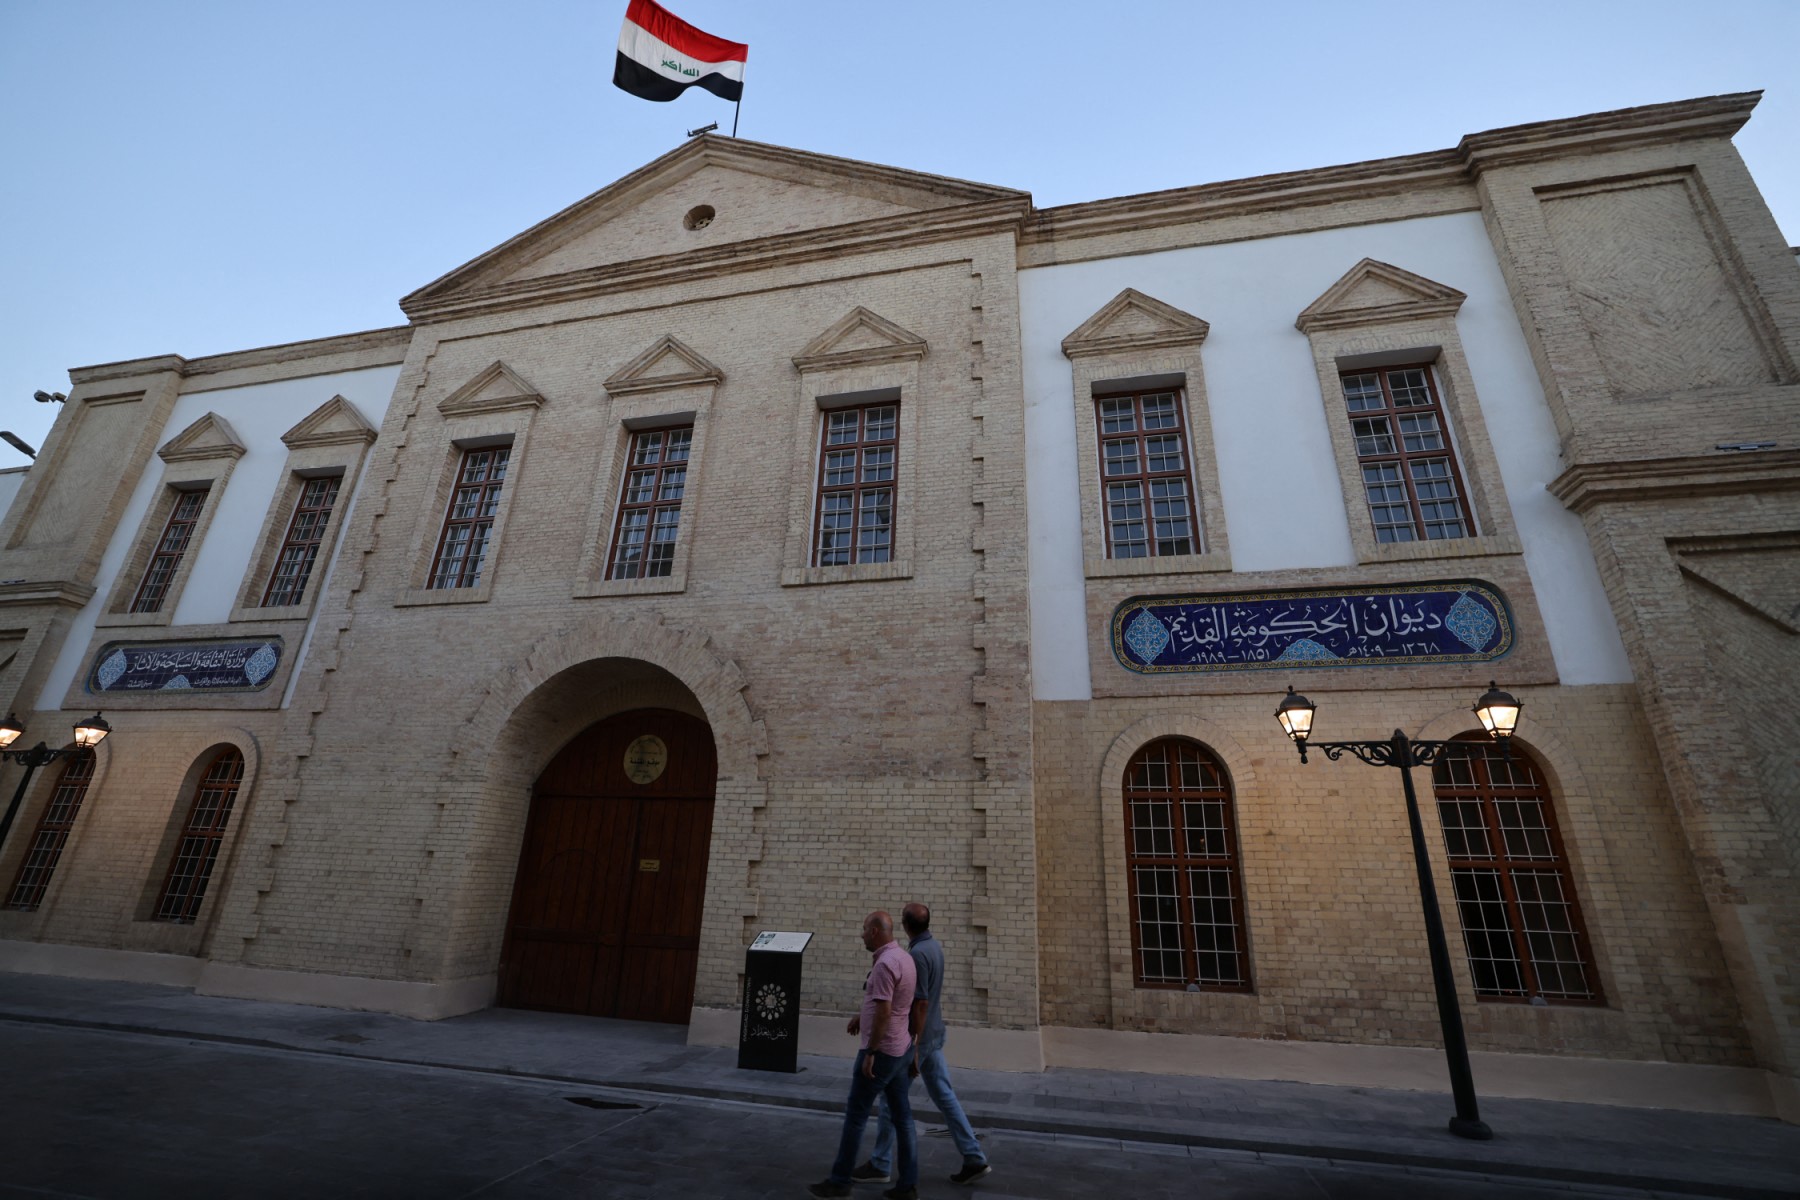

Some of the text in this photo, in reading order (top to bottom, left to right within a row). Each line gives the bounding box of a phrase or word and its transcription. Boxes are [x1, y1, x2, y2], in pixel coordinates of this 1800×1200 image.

[682, 68, 699, 77] الله
[1230, 599, 1359, 647] الحكومة
[1364, 596, 1442, 637] ديوان
[200, 650, 230, 668] الثقافة
[226, 647, 246, 669] وزارة
